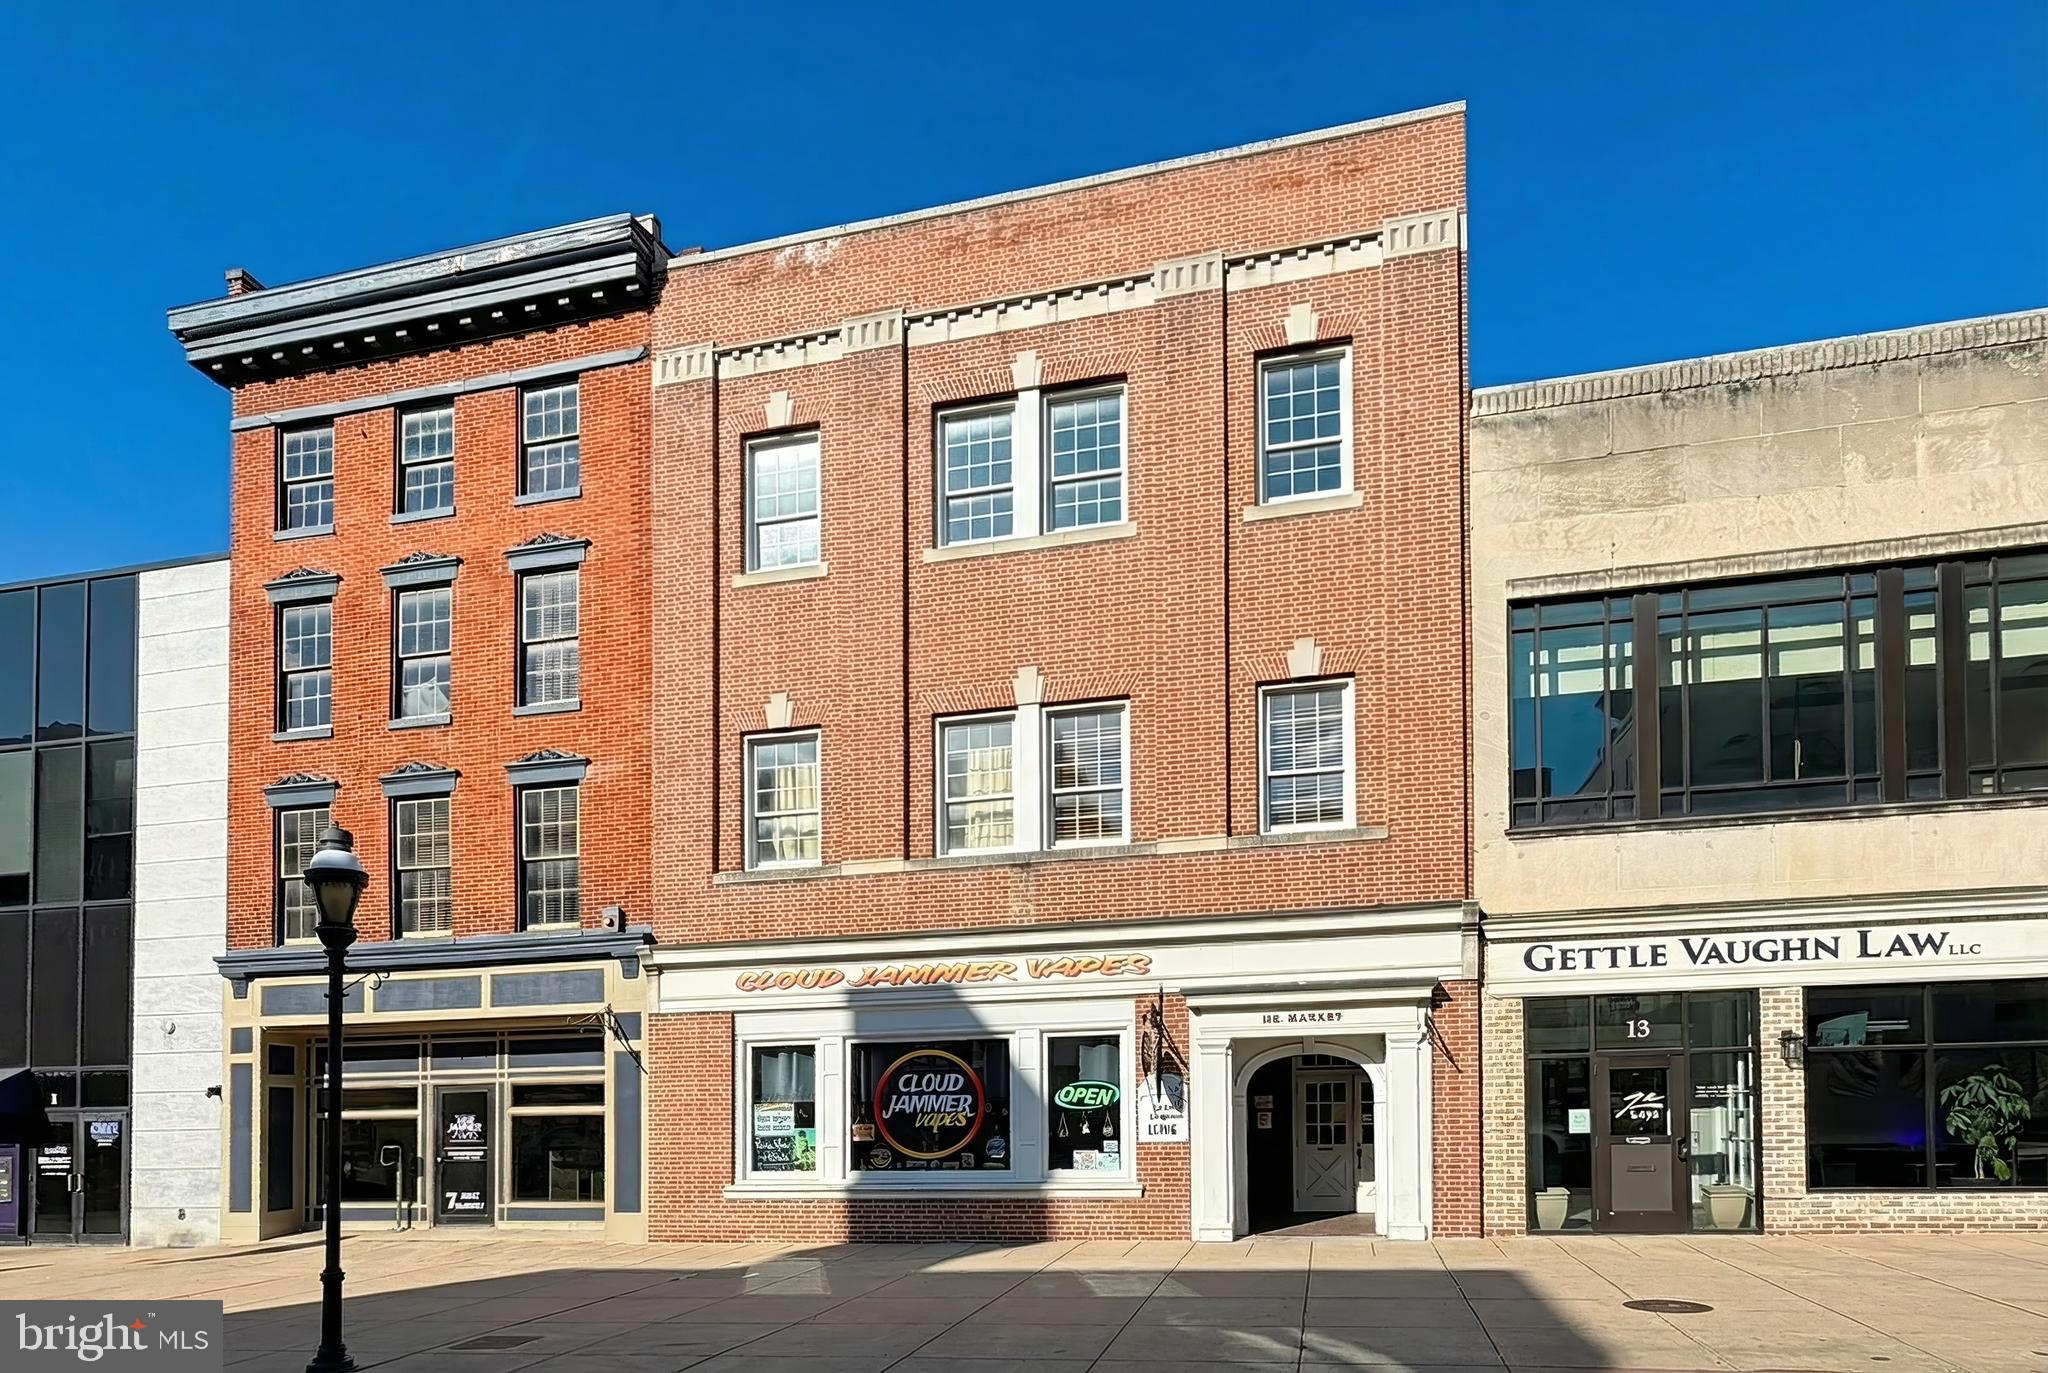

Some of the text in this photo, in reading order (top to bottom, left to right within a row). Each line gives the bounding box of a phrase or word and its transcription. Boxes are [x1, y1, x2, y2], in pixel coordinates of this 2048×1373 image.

[1523, 930, 1981, 972] GETTLE VAUGHN LAW LLC
[735, 953, 1153, 993] CLOUD JAMMER VAPES
[1626, 1019, 1651, 1038] 13
[898, 1073, 965, 1093] CLOUD
[882, 1094, 977, 1119] JAMMER
[1060, 1085, 1114, 1106] OPEN
[915, 1110, 968, 1133] vapes
[445, 1191, 458, 1210] 7
